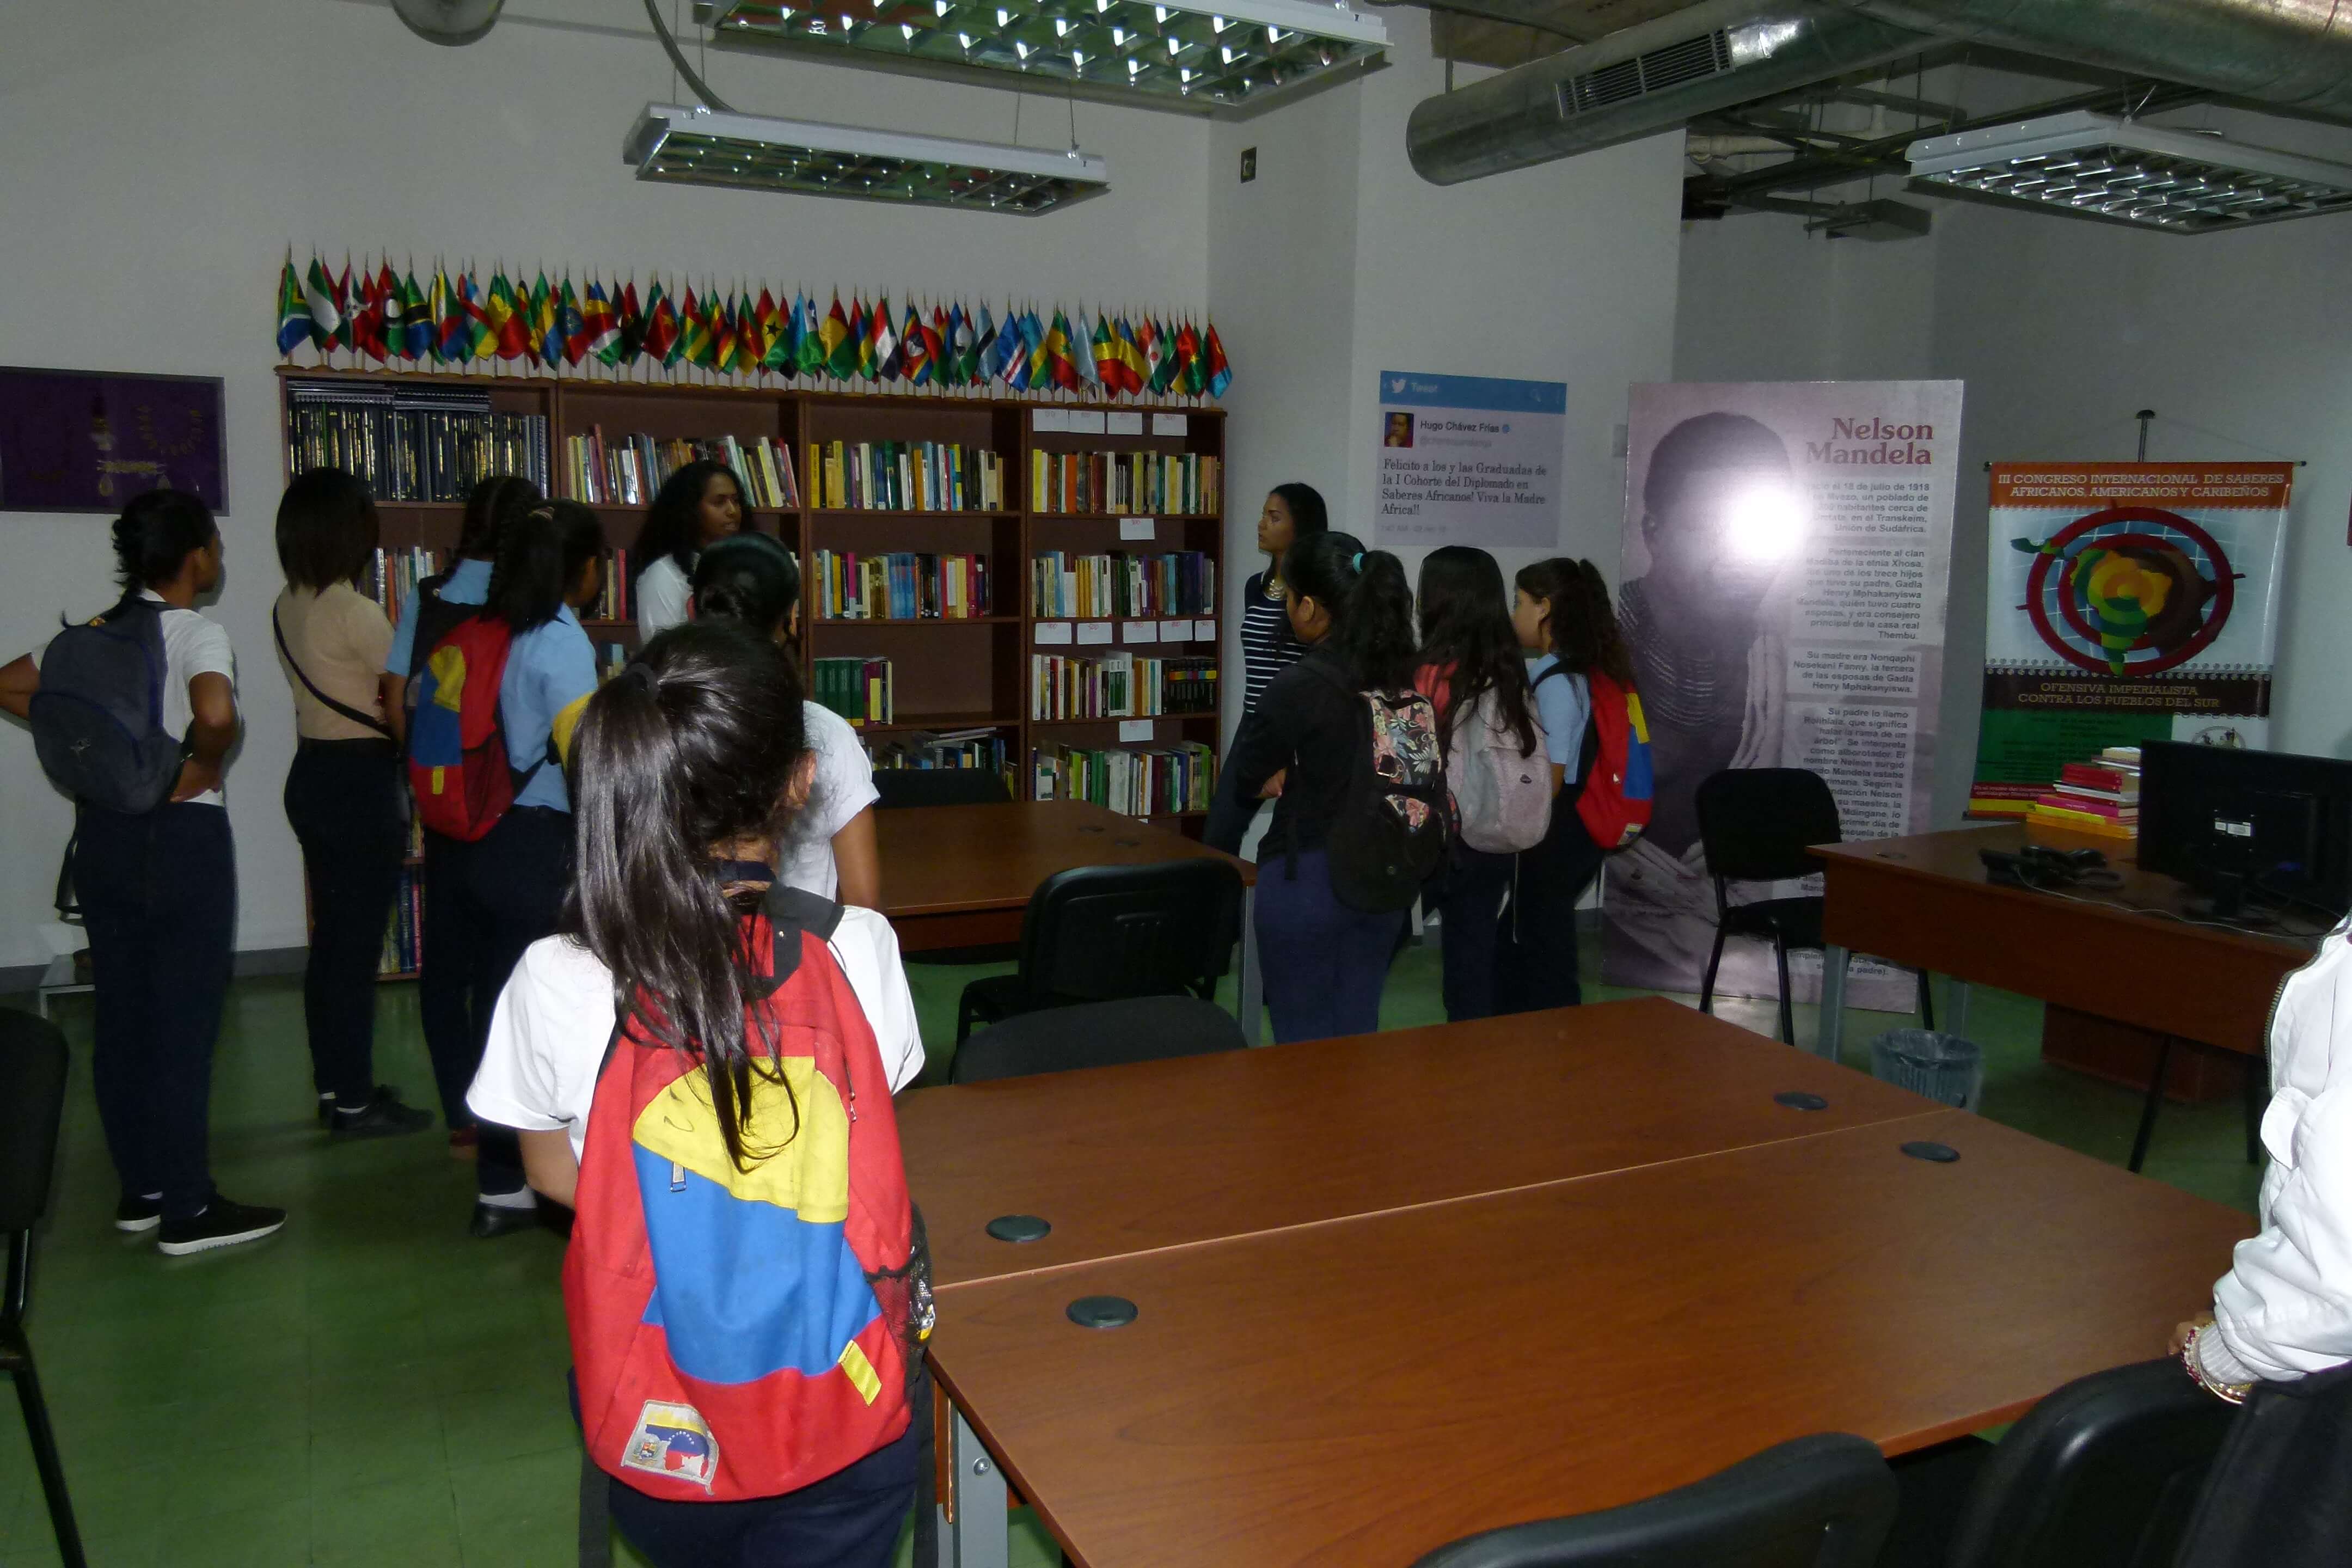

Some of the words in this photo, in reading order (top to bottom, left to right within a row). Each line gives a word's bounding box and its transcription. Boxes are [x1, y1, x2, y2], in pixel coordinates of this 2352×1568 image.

[1420, 420, 1442, 431] Hugo
[1446, 421, 1476, 431] Chávez
[1479, 424, 1499, 432] Frías
[1832, 417, 1933, 440] Nelson
[1806, 442, 1932, 465] Mandela
[1384, 460, 1420, 471] Felicito
[1432, 461, 1446, 472] los
[1449, 465, 1455, 476] y
[1459, 462, 1473, 473] las
[1476, 462, 1532, 475] Graduadas
[1535, 464, 1546, 475] de
[1382, 474, 1392, 485] la
[1395, 474, 1400, 485] I
[1404, 474, 1442, 486] Cohorte
[1445, 476, 1460, 487] del
[1464, 476, 1514, 491] Diplomado
[1516, 481, 1528, 489] en
[1999, 474, 2011, 484] III
[2013, 474, 2087, 484] CONGRESO
[2090, 474, 2197, 484] INTERNACIONAL
[2203, 474, 2224, 484] DE
[2226, 474, 2284, 484] SABERES
[1871, 483, 1890, 492] julio
[2089, 487, 2177, 497] AMERICANOS
[2178, 487, 2189, 497] Y
[2191, 485, 2269, 497] CARIBEÑOS
[1382, 489, 1422, 501] Saberes
[1425, 490, 1473, 502] Africanos!
[1477, 492, 1498, 503] Viva
[1502, 492, 1510, 503] la
[1514, 492, 1545, 504] Madre
[1877, 494, 1914, 503] poblado
[1879, 525, 1926, 533] Sudáfrica.
[1900, 570, 1922, 579] hijos
[1824, 589, 1849, 598] Henry
[1853, 590, 1921, 599] Mphakanyiswa
[1874, 611, 1920, 620] consejero
[1810, 619, 1849, 628] principal
[1870, 653, 1915, 663] Nonqaphi
[1882, 664, 1914, 672] tercera
[1812, 682, 1839, 691] Henry
[2041, 683, 2105, 693] OFENSIVA
[2108, 685, 2198, 695] IMPERIALISTA
[2018, 694, 2073, 703] CONTRA
[2075, 695, 2102, 704] LOS
[2105, 696, 2161, 706] PUEBLOS
[2165, 697, 2191, 707] DEL
[2194, 699, 2221, 707] SUR
[1843, 709, 1869, 717] padre
[1869, 719, 1907, 728] significa
[1862, 739, 1905, 749] interpreta
[1841, 758, 1872, 767] Nelson
[1833, 768, 1870, 776] Mandela
[1863, 780, 1891, 789] Según
